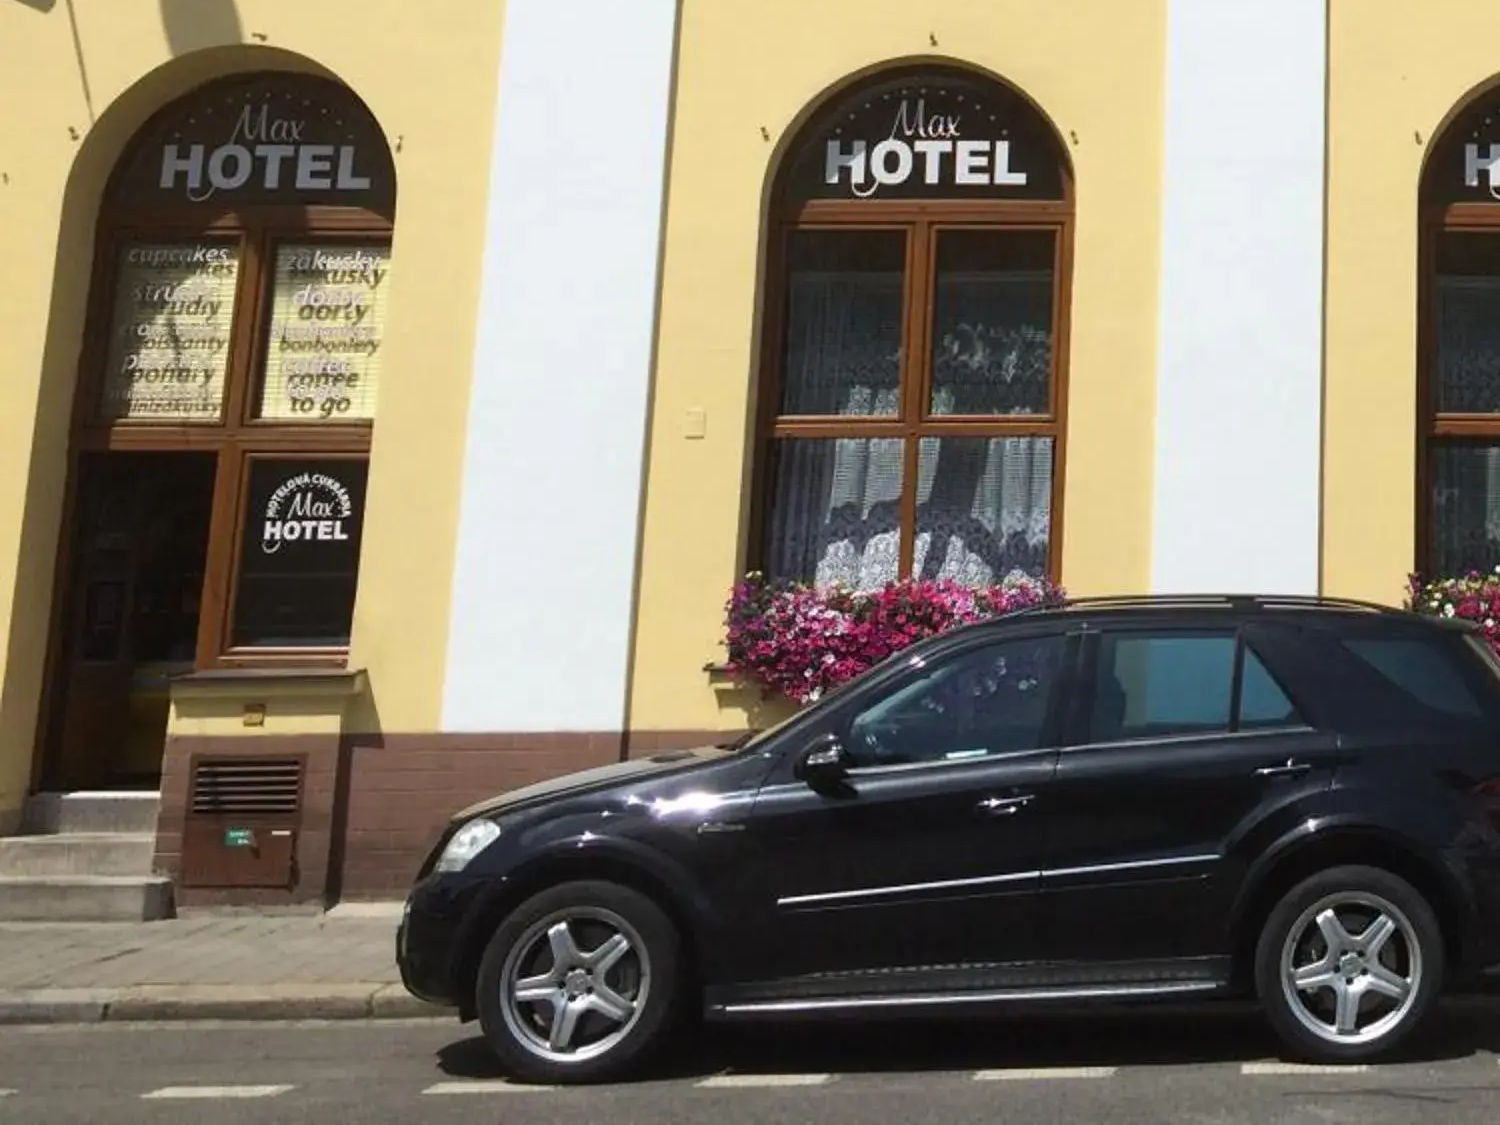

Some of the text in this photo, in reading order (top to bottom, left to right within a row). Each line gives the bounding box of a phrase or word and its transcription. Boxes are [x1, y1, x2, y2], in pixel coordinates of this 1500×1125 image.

[231, 104, 305, 142] Max
[890, 99, 960, 139] Max
[159, 144, 370, 190] HOTEL
[824, 139, 1027, 185] HOTEL
[321, 396, 351, 418] go
[287, 491, 335, 520] Max
[263, 520, 348, 540] HOTEL
